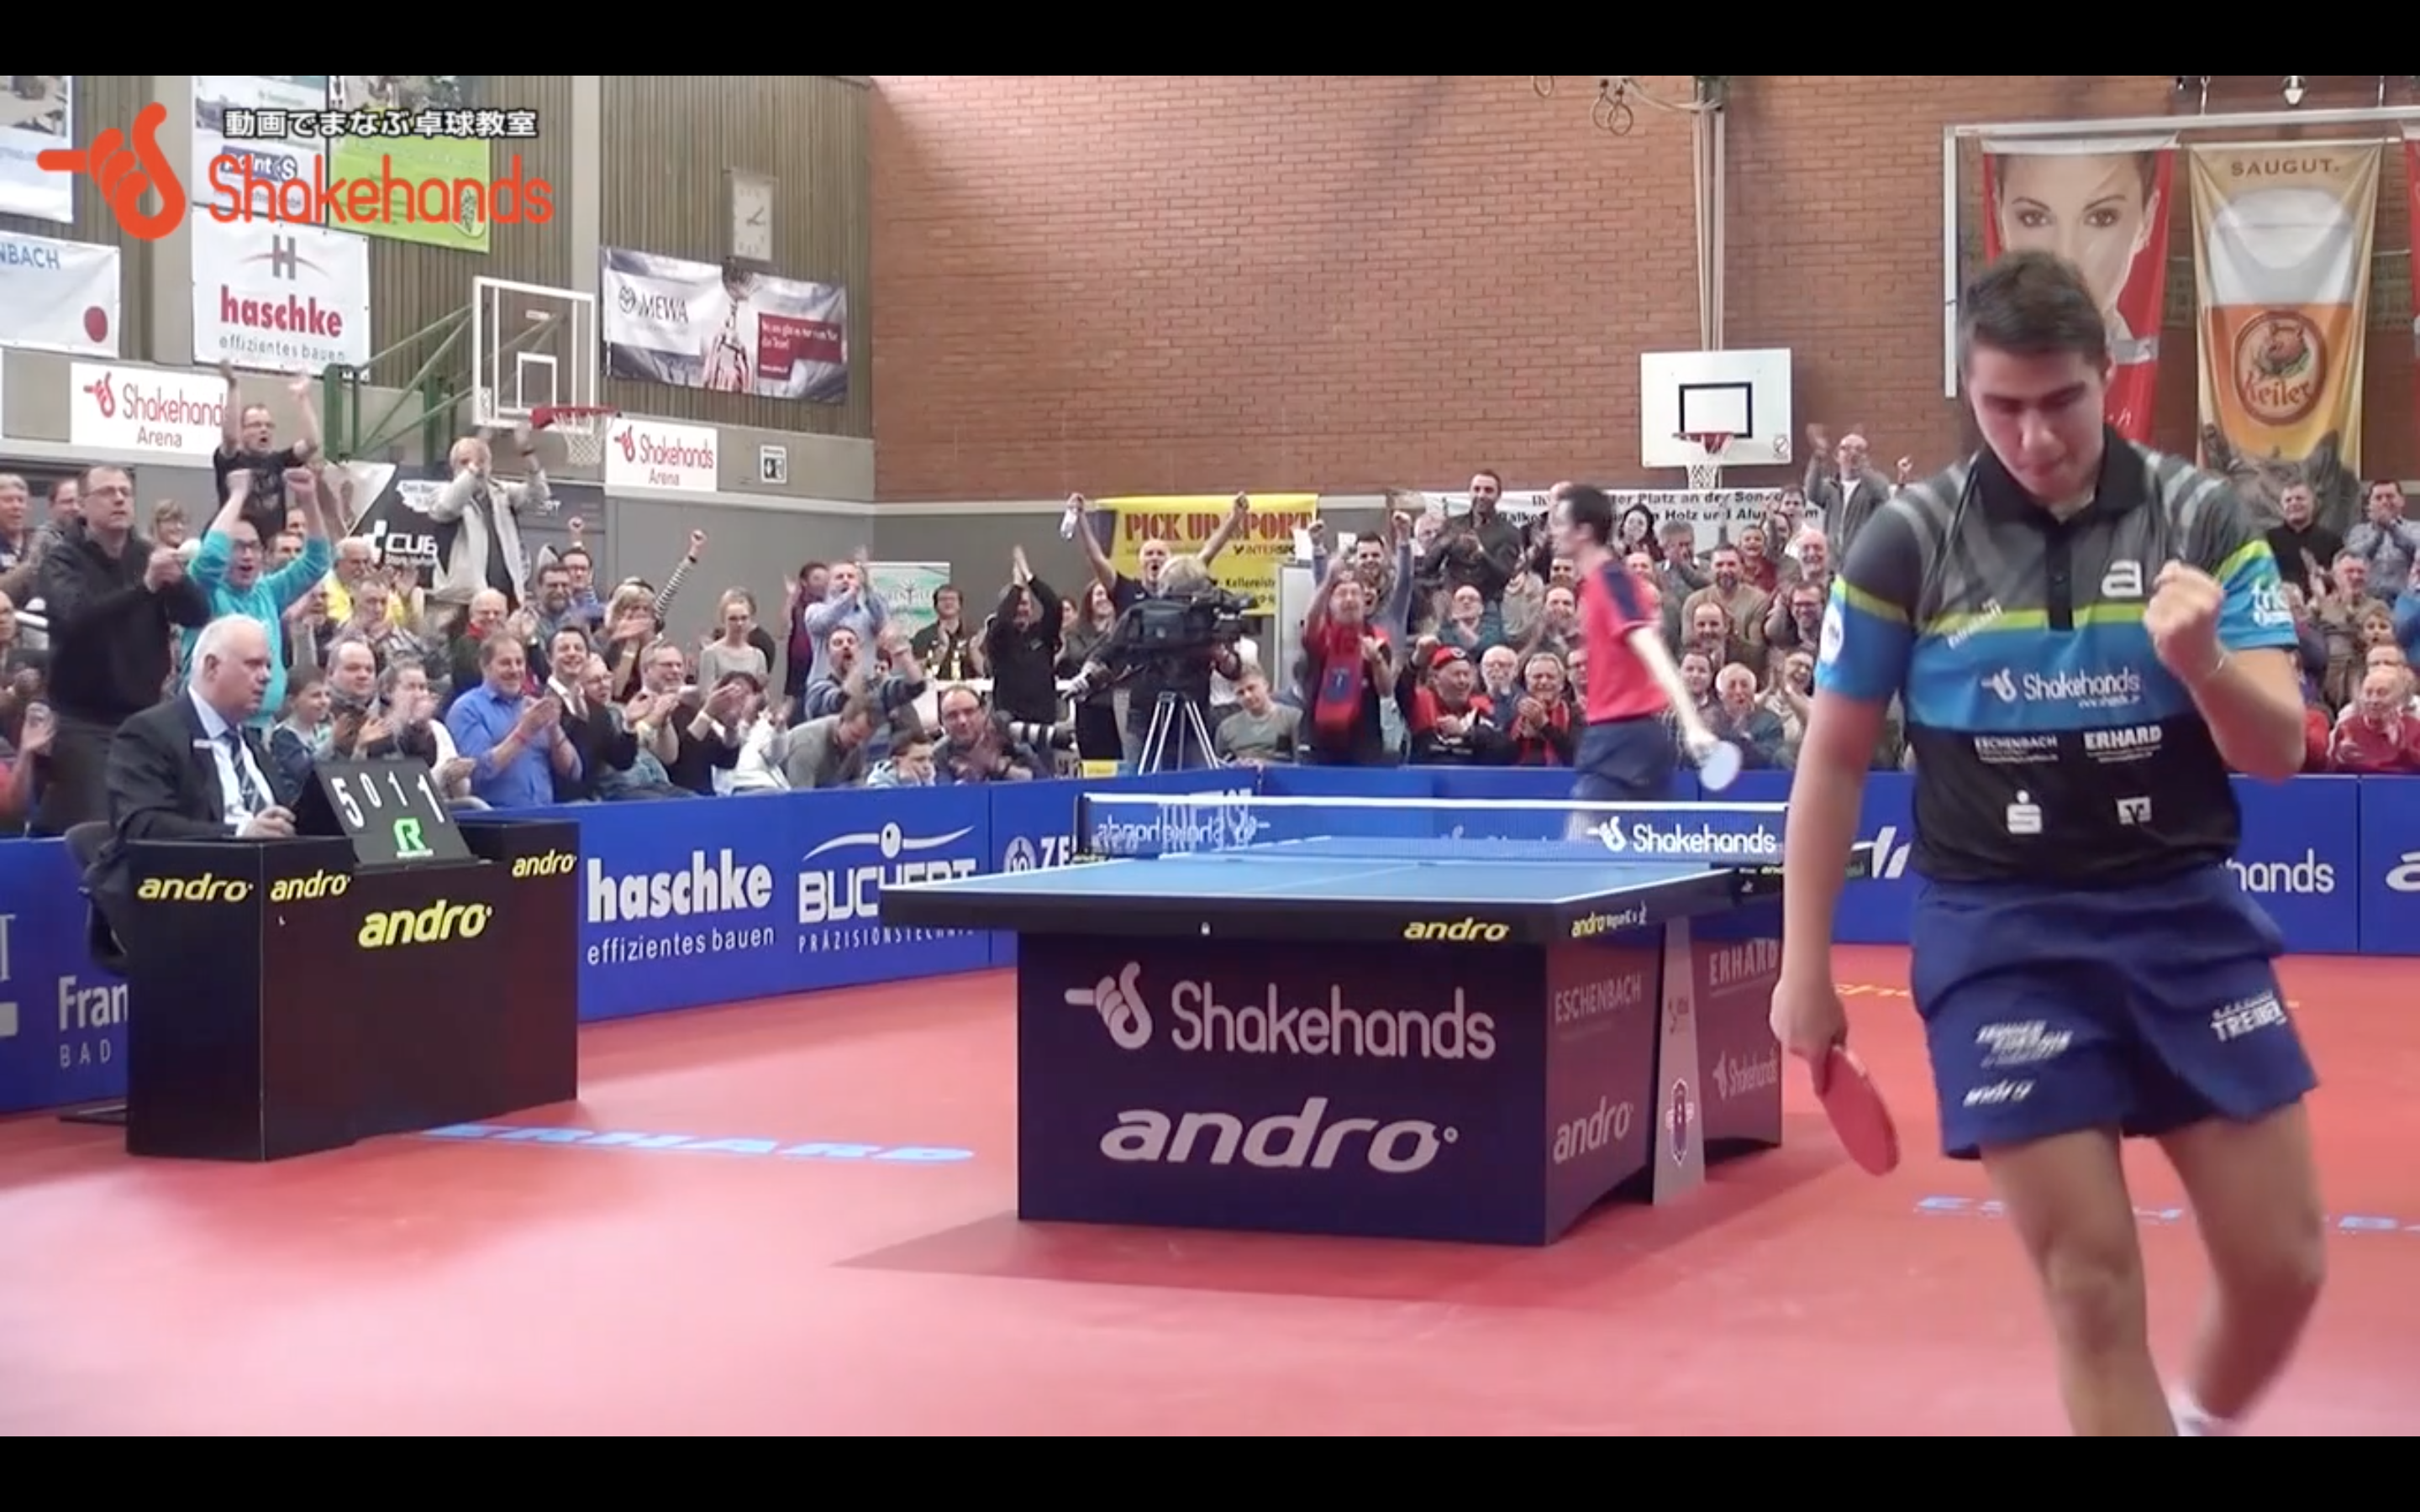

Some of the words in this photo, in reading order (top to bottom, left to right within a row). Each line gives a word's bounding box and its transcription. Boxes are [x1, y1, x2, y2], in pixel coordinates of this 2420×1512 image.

[2230, 159, 2341, 176] SAUGUT.
[222, 283, 343, 338] haschke
[638, 293, 689, 323] MEWA
[219, 334, 297, 358] effizientes
[302, 344, 345, 363] bauen
[123, 383, 228, 428] Shakehand
[137, 427, 182, 448] Arena
[639, 433, 713, 470] Shakehands
[649, 469, 680, 486] Arena
[1125, 513, 1182, 541] PICK
[1232, 512, 1313, 541] PORT
[2023, 667, 2141, 702] Shakehands
[2084, 725, 2163, 750] ERHARD
[1633, 823, 1776, 854] Shakehands
[512, 848, 577, 878] andro
[137, 872, 254, 902] andro
[270, 869, 350, 902] andro
[587, 848, 772, 923] haschke
[358, 899, 493, 948] andro
[1403, 916, 1510, 942] andro
[587, 932, 707, 966] effizientes
[712, 926, 775, 952] bauen
[1709, 937, 1781, 986] ERHARD
[1555, 974, 1642, 1024] ESCHENBACH
[1171, 979, 1497, 1060] Shakehands
[423, 1123, 975, 1162] ERHARD
[1099, 1096, 1460, 1173] andro
[1553, 1095, 1634, 1165] andro
